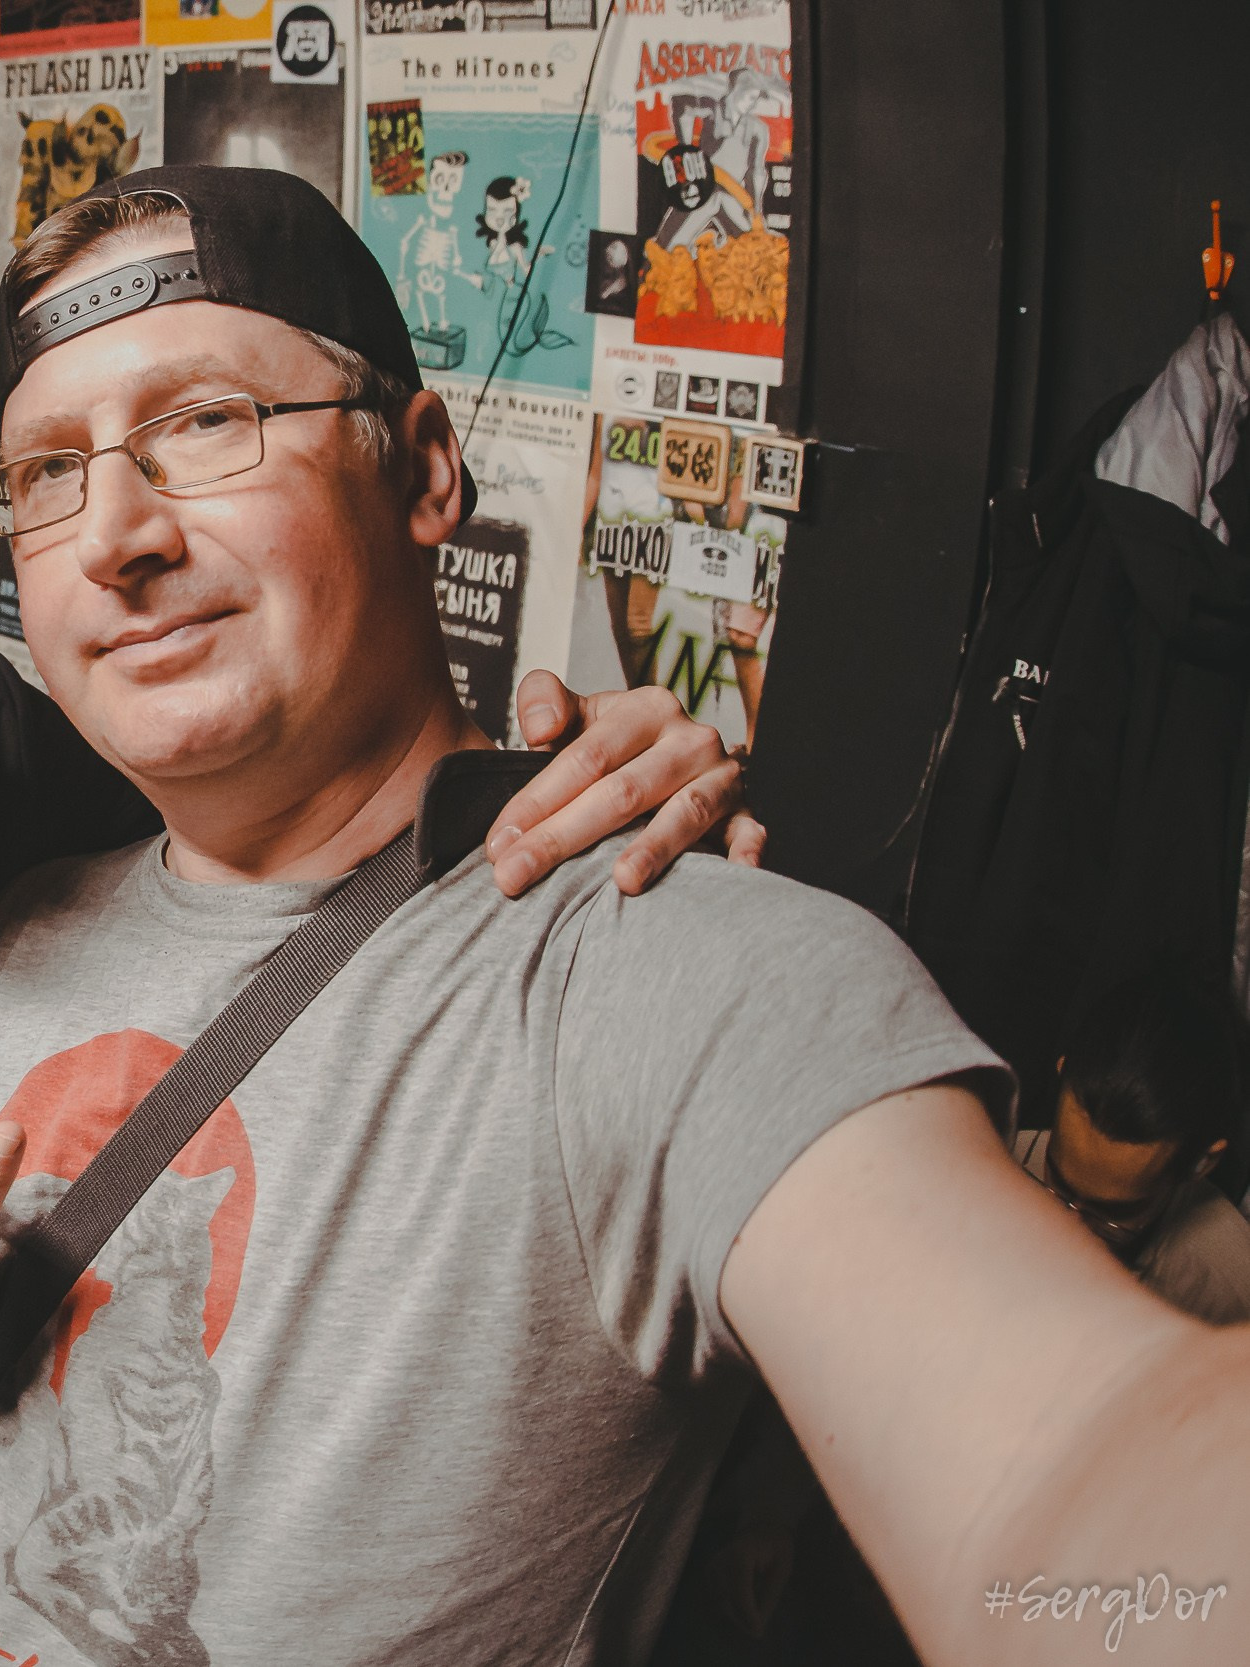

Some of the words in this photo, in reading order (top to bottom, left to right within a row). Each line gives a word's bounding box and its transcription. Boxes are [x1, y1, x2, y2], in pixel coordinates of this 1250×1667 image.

[5, 59, 91, 98] FFLASH
[101, 53, 150, 91] DAY
[402, 58, 442, 79] The
[456, 56, 556, 79] HiTones
[508, 396, 584, 422] Nouvelle
